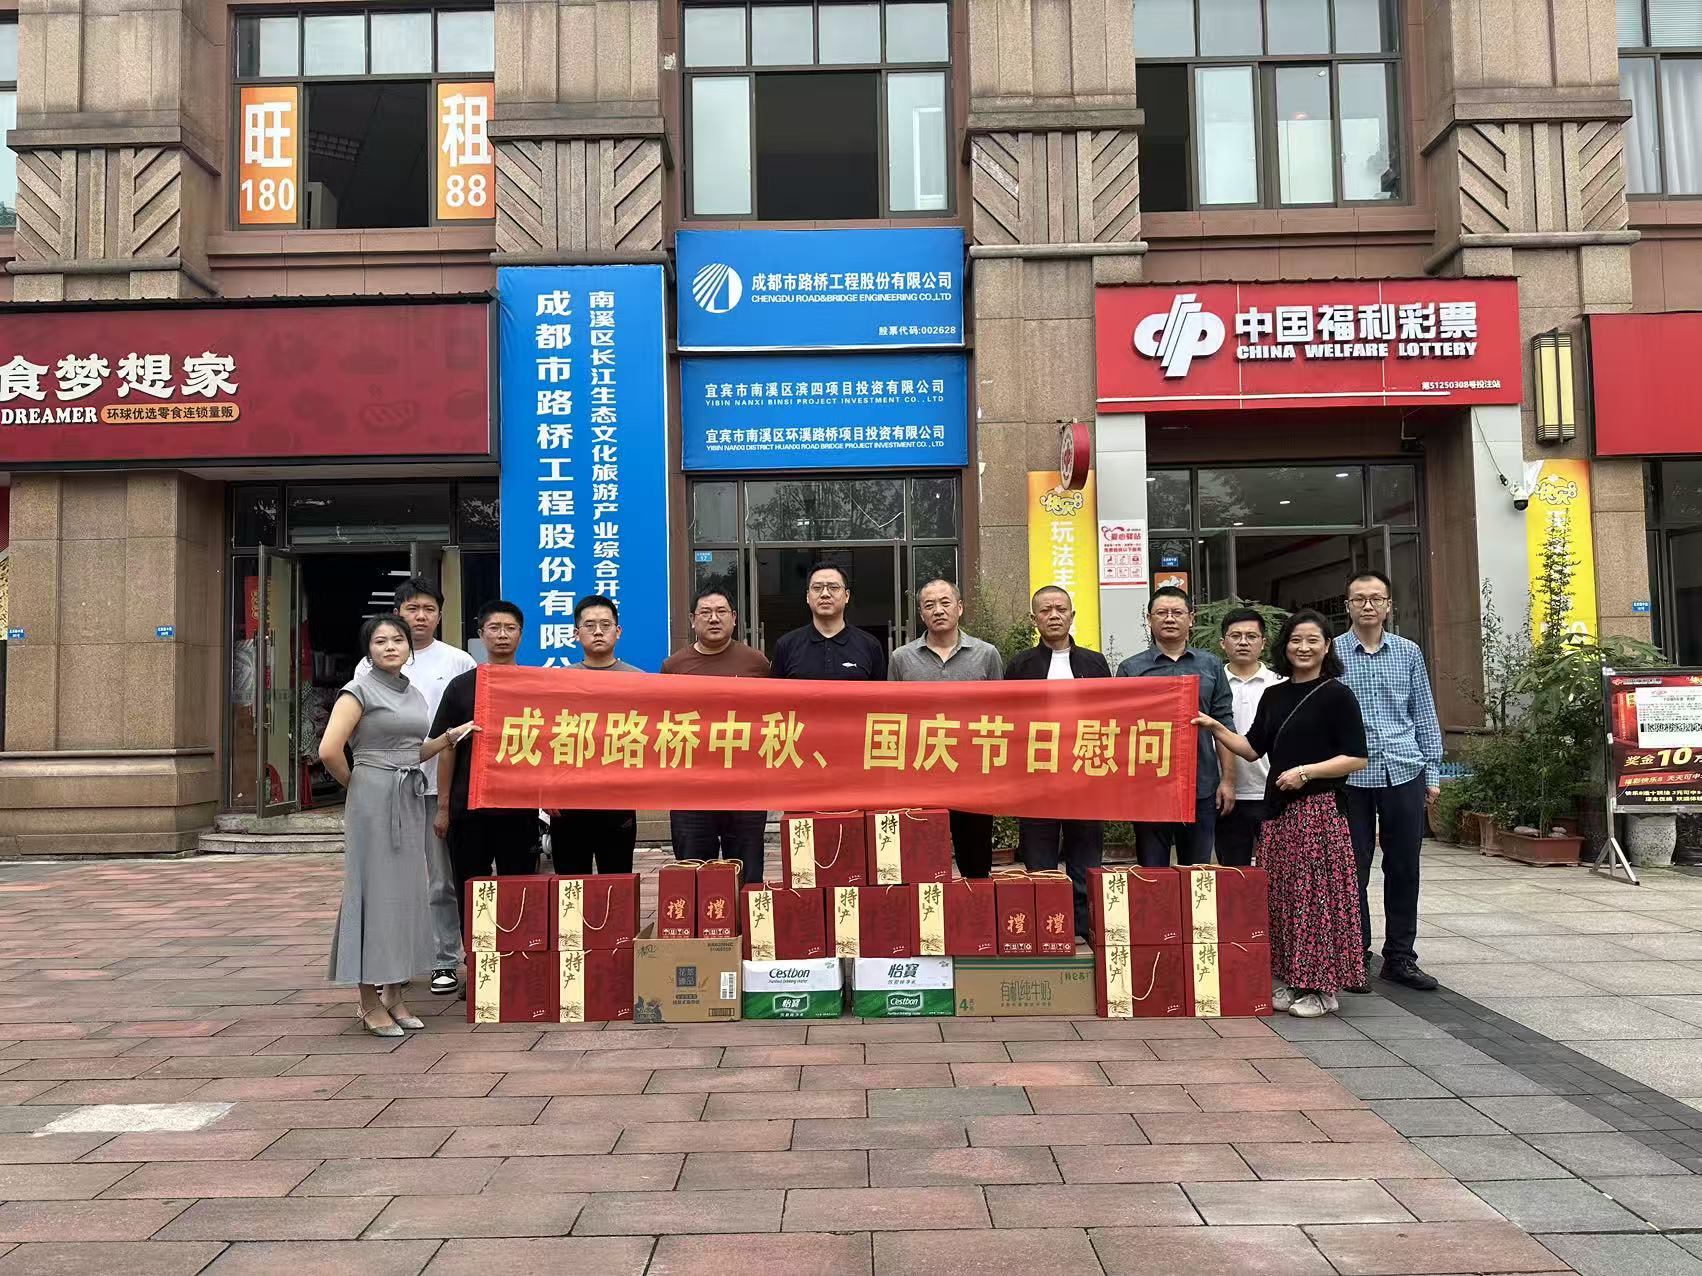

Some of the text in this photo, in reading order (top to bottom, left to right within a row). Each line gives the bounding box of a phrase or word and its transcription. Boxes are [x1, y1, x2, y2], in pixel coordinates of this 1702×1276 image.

[245, 102, 292, 168] 旺
[442, 93, 491, 167] 租
[241, 177, 295, 211] 180
[446, 174, 487, 207] 88
[751, 294, 795, 303] CHENGDU
[796, 293, 858, 302] ROAD&BRIDGE
[860, 293, 918, 302] ENGINEERING
[752, 271, 952, 291] 成都市路桥工程股份有限公司
[878, 326, 956, 336] 股票代码:002628
[1235, 301, 1477, 343] 中国福利彩票
[1236, 341, 1477, 359] CHINA WELFARE LOTTERY
[0, 350, 239, 401] 食梦想家
[705, 380, 944, 398] 宜宾市南溪区滨四项目投资有限公司
[1, 407, 98, 425] DREAMER
[106, 406, 233, 420] 环球优选零食连锁量贩
[705, 425, 945, 443] 宜宾市南溪区环溪路桥项目投资有限公司
[589, 291, 620, 616] 南溪区长江生态文化旅游产业综合开
[495, 707, 1173, 777] 成都路桥中秋、国庆节日慰问
[794, 819, 811, 856] 特产
[880, 814, 898, 851] 特产
[477, 882, 496, 918] 特产
[563, 881, 582, 918] 特产
[839, 888, 857, 924] 特产
[923, 884, 941, 922] 特产
[1108, 873, 1126, 911] 特产
[1196, 872, 1214, 909] 特产
[754, 891, 771, 928] 特产
[479, 952, 499, 990] 特产
[563, 952, 583, 989] 特产
[1110, 946, 1129, 983] 特产
[1199, 945, 1217, 982] 特产
[1000, 980, 1051, 1001] 有机纯牛奶
